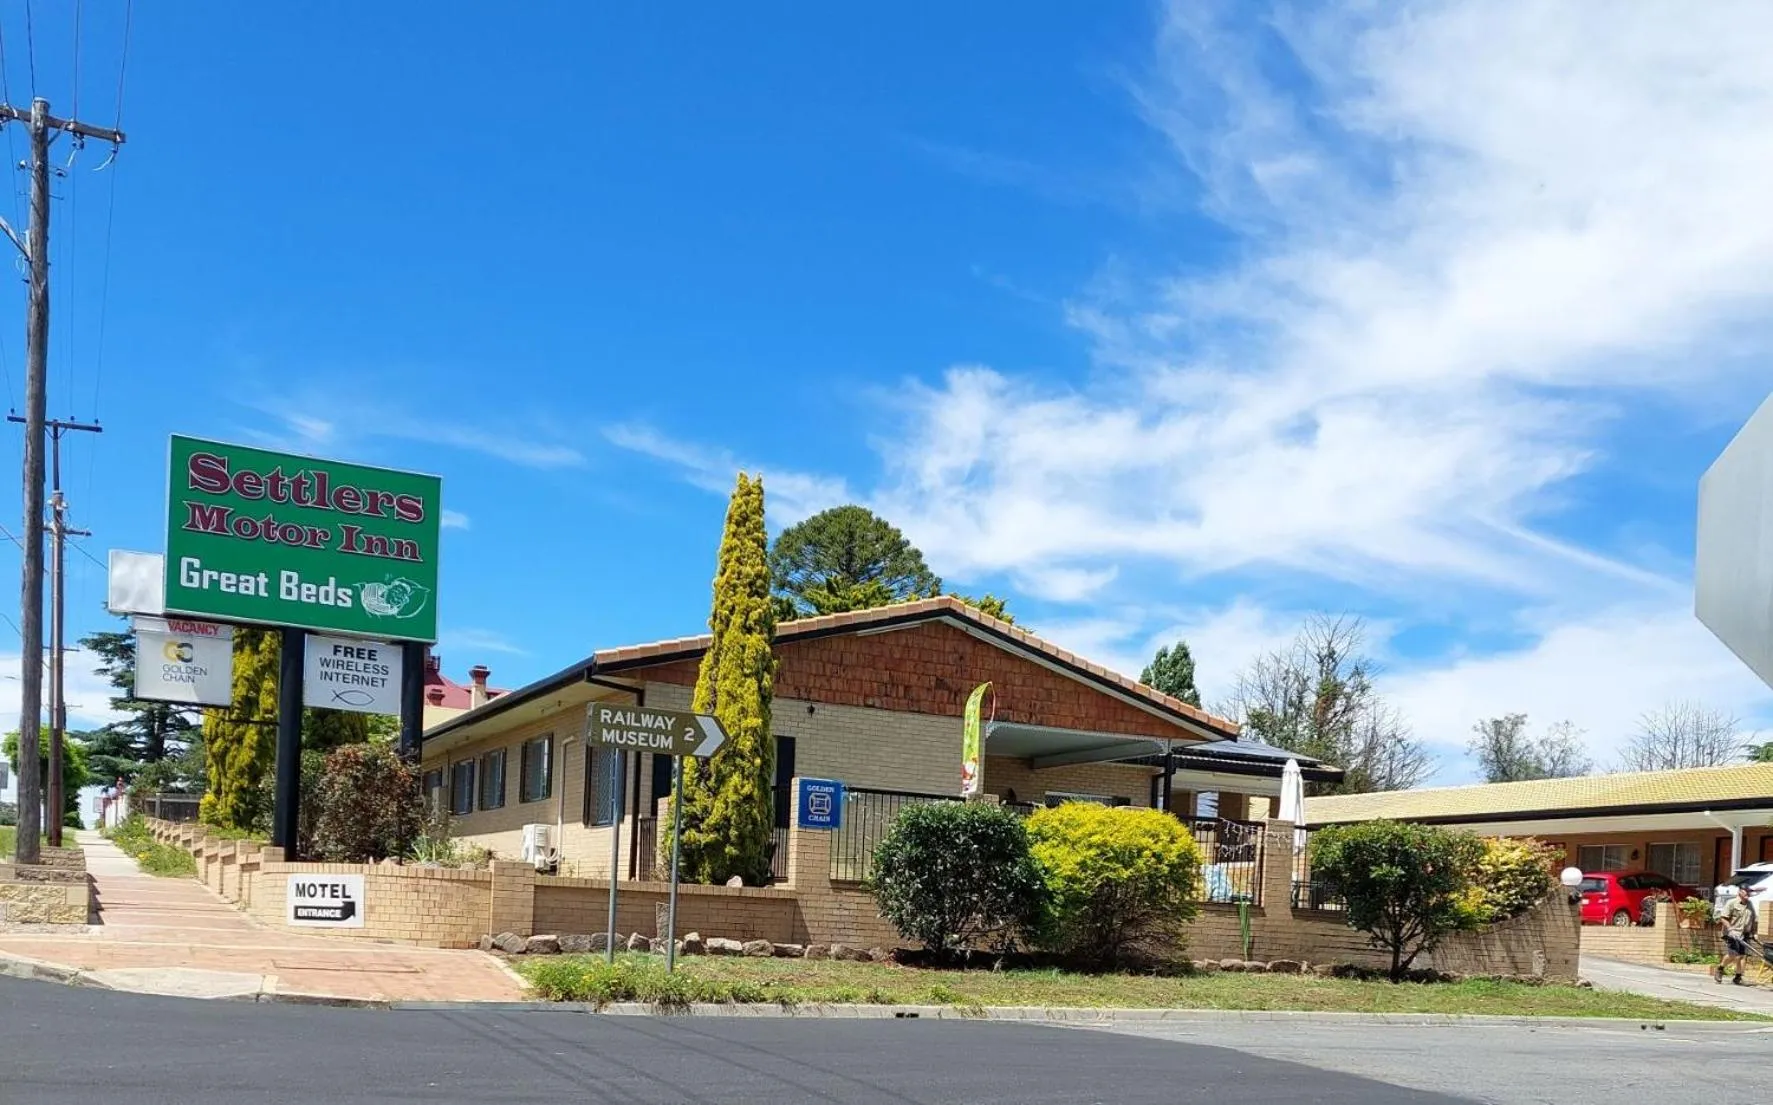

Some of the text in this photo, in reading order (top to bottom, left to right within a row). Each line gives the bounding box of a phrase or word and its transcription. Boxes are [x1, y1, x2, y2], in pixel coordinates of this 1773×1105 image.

[188, 452, 425, 524] Settlers
[181, 500, 424, 562] Motor Inn
[180, 556, 353, 608] Great Beds
[167, 620, 220, 636] VACANCY
[333, 644, 378, 662] FREE
[162, 664, 208, 676] GOLDEN
[319, 656, 390, 677] WIRELESS
[162, 673, 196, 684] CHAIN
[319, 670, 389, 689] INTERNET
[600, 708, 677, 731] RAILWAY
[601, 727, 696, 750] MUSEUM 2
[806, 784, 835, 793] GOLDEN
[295, 882, 352, 899] MOTEL
[297, 908, 342, 918] ENTRANCE
